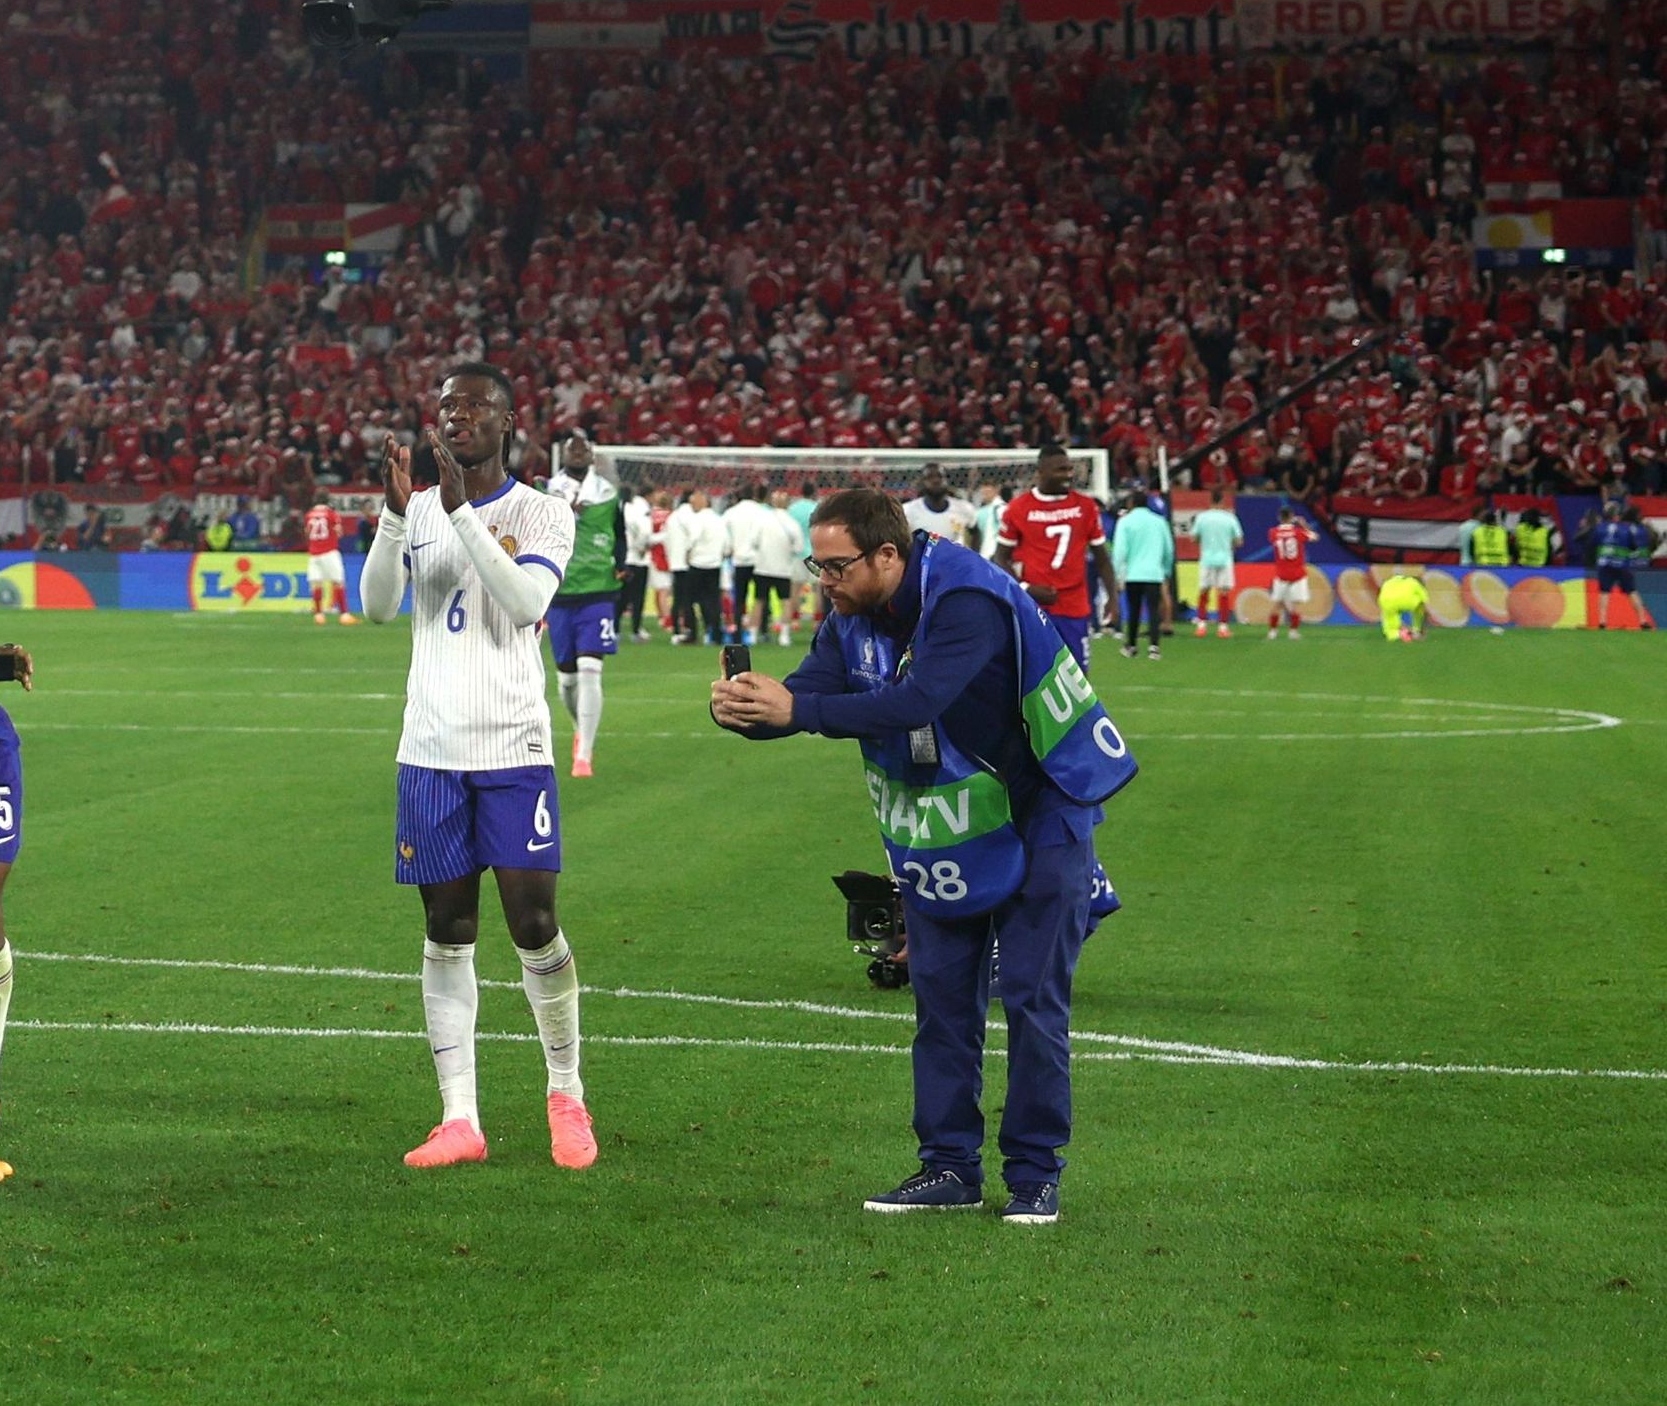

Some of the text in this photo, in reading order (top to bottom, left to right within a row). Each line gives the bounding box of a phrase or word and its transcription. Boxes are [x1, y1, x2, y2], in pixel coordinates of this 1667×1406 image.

[1275, 0, 1367, 35] RED
[1045, 524, 1072, 569] 7
[446, 589, 467, 634] 6
[534, 789, 552, 838] 6
